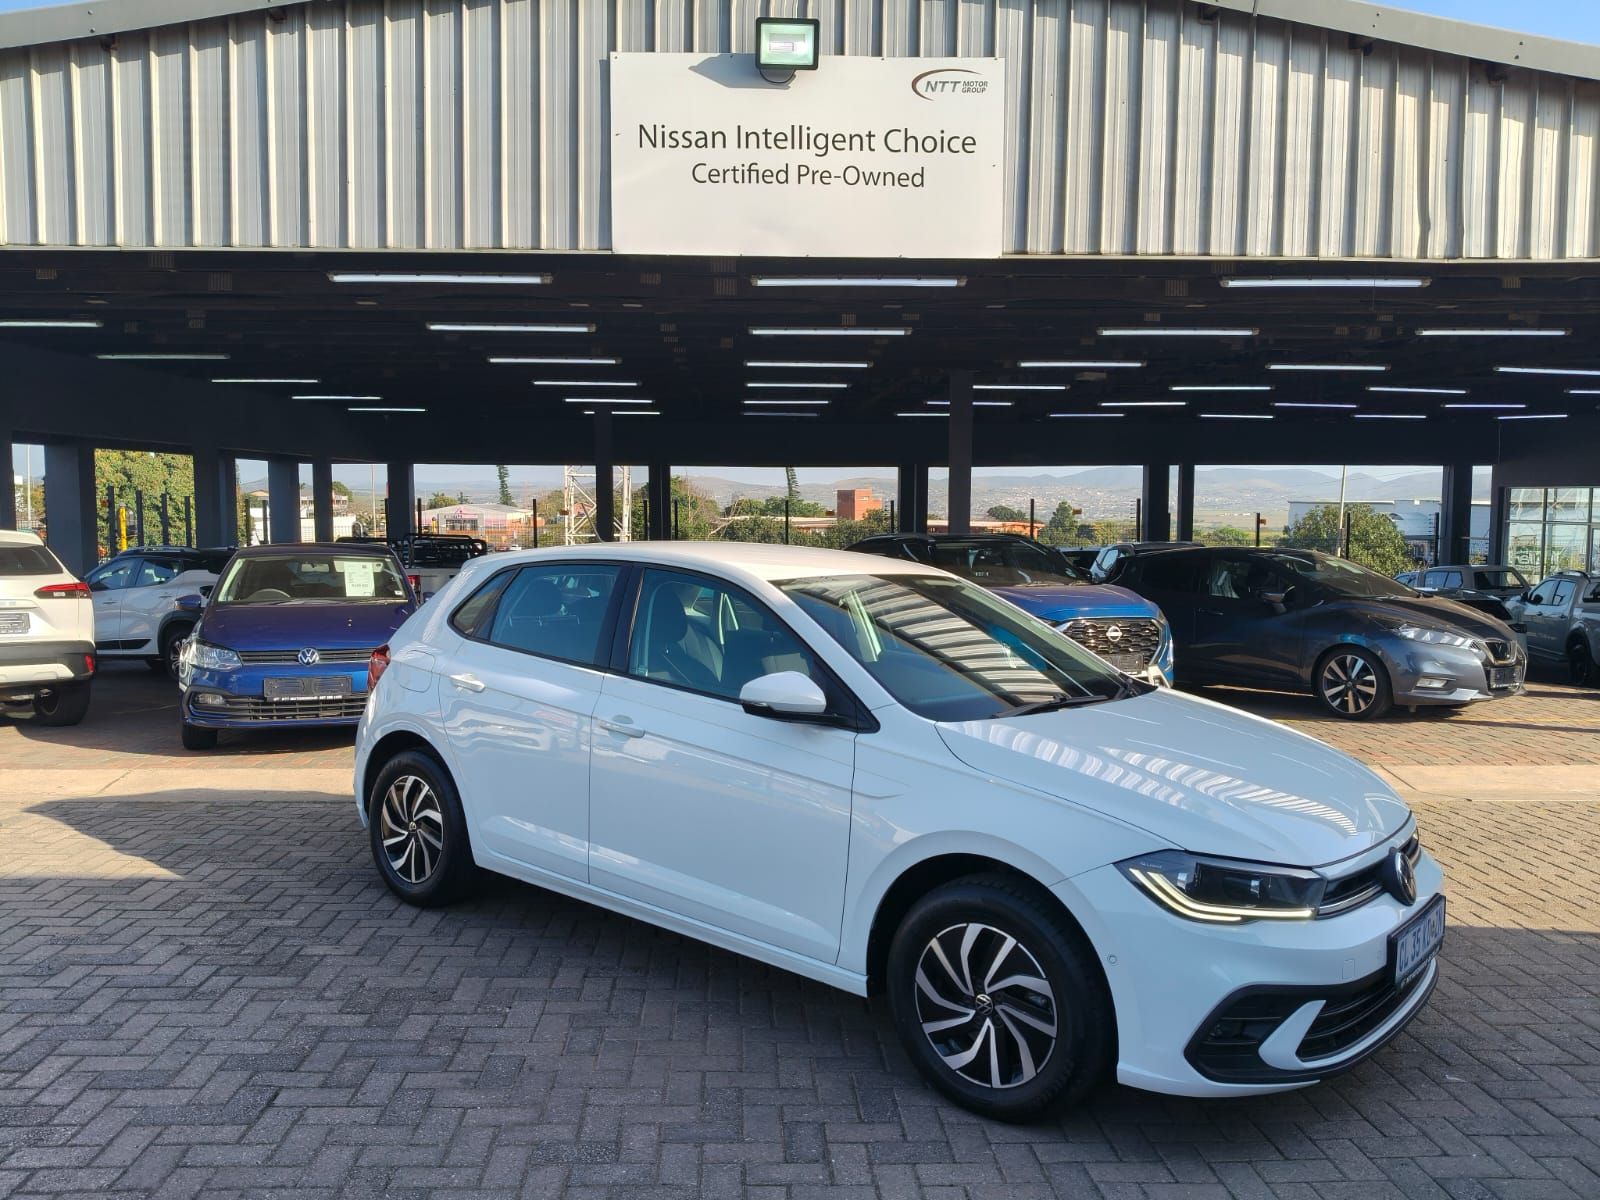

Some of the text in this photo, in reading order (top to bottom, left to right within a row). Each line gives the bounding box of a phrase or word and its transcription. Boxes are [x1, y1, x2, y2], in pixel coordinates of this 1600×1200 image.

[924, 80, 961, 93] NTT
[962, 80, 989, 88] MOTOR
[638, 123, 977, 157] Nissan Intelligent Choice
[691, 162, 925, 188] Certified Pre-Owned
